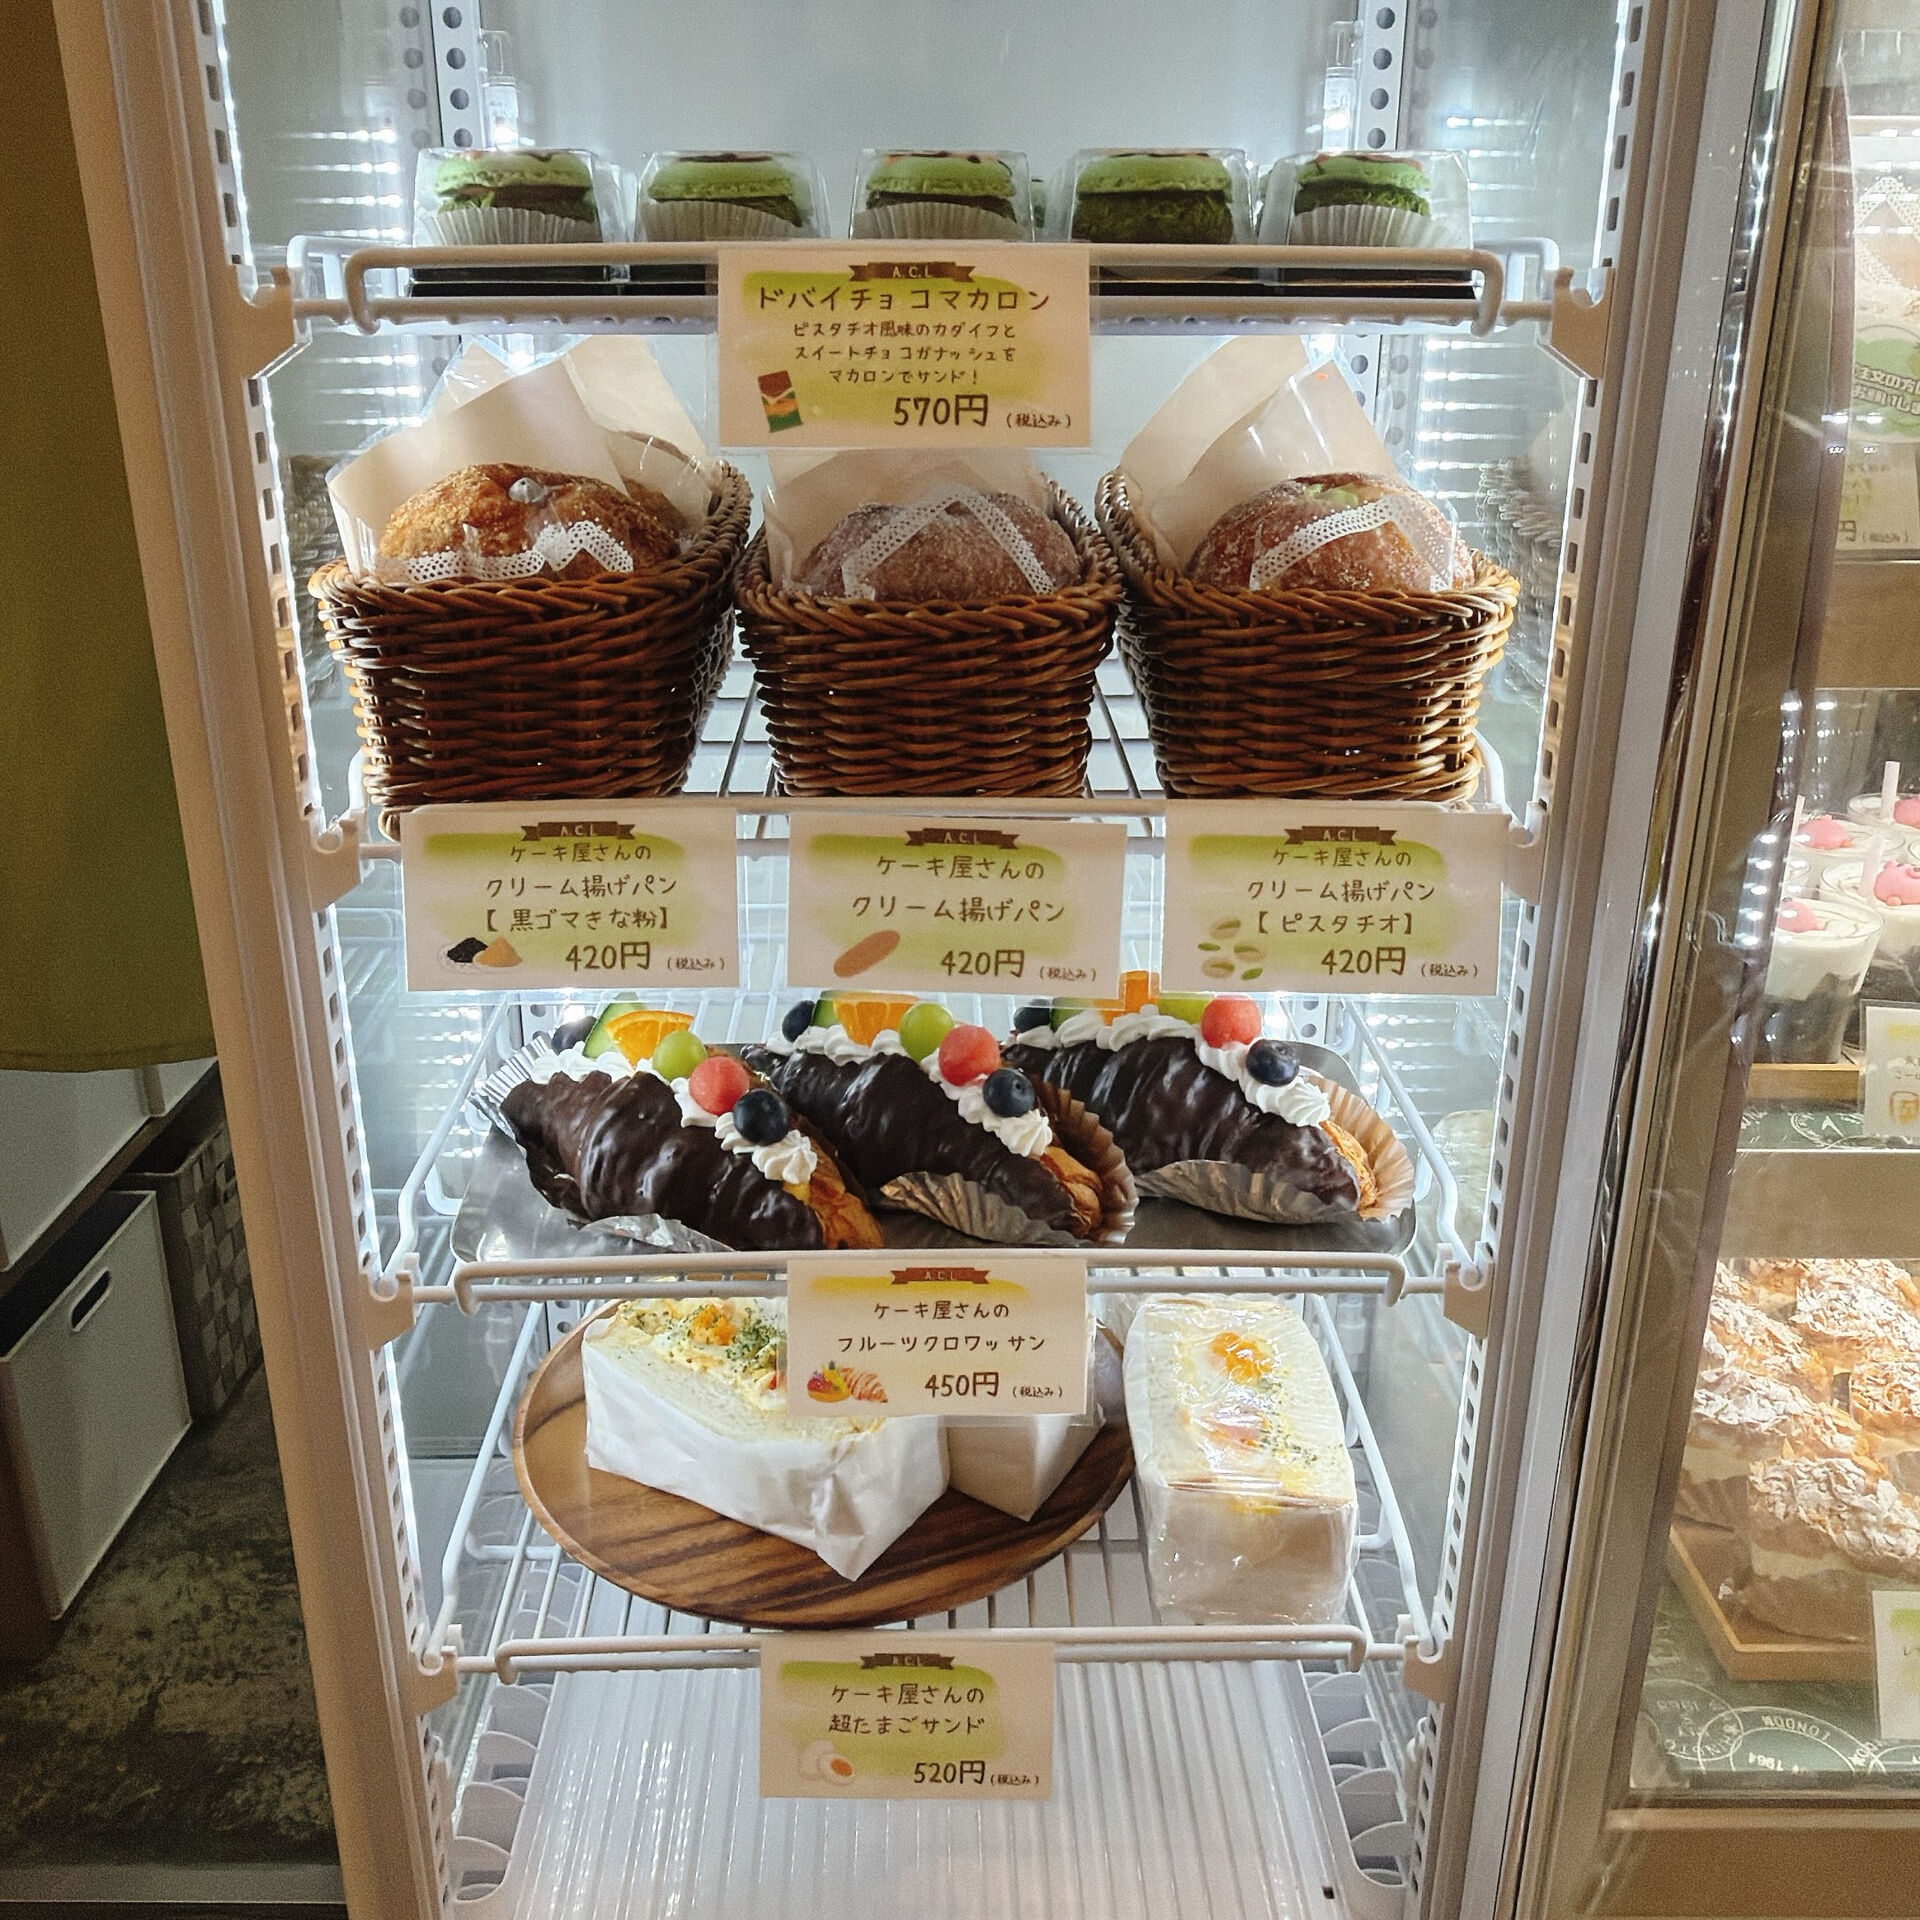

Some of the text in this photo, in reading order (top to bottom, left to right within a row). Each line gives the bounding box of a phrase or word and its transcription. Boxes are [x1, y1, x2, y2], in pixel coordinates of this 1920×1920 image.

[759, 286, 1050, 311] ドバイチョコマカロン
[793, 321, 1017, 338] ピスタチオ風味のカダイフと
[795, 345, 1017, 362] スイートチョコガナッシュを
[893, 393, 990, 428] 570円
[510, 842, 651, 863] ケーキ屋さんの
[1273, 848, 1412, 867] ケーキ屋さんの
[876, 855, 1045, 880] ケーキ屋さんの
[486, 875, 678, 899] クリーム揚げパン
[1247, 879, 1436, 903] クリーム揚げパン
[486, 908, 669, 932] 【黒ゴマきな粉】
[852, 895, 1066, 923] クリーム揚げパン
[1258, 910, 1414, 935] 【ピスタチオ】
[565, 941, 651, 971] 420円
[940, 949, 1025, 977] 420円
[1321, 946, 1406, 976] 420円
[874, 1300, 1010, 1320] ケーキ屋さんの
[837, 1334, 1046, 1353] フルーツクロワッサン
[924, 1371, 999, 1398] 450円
[831, 1683, 985, 1705] ケーキ屋さんの
[828, 1714, 986, 1735] 超たまごサンド
[913, 1760, 987, 1785] 520円
